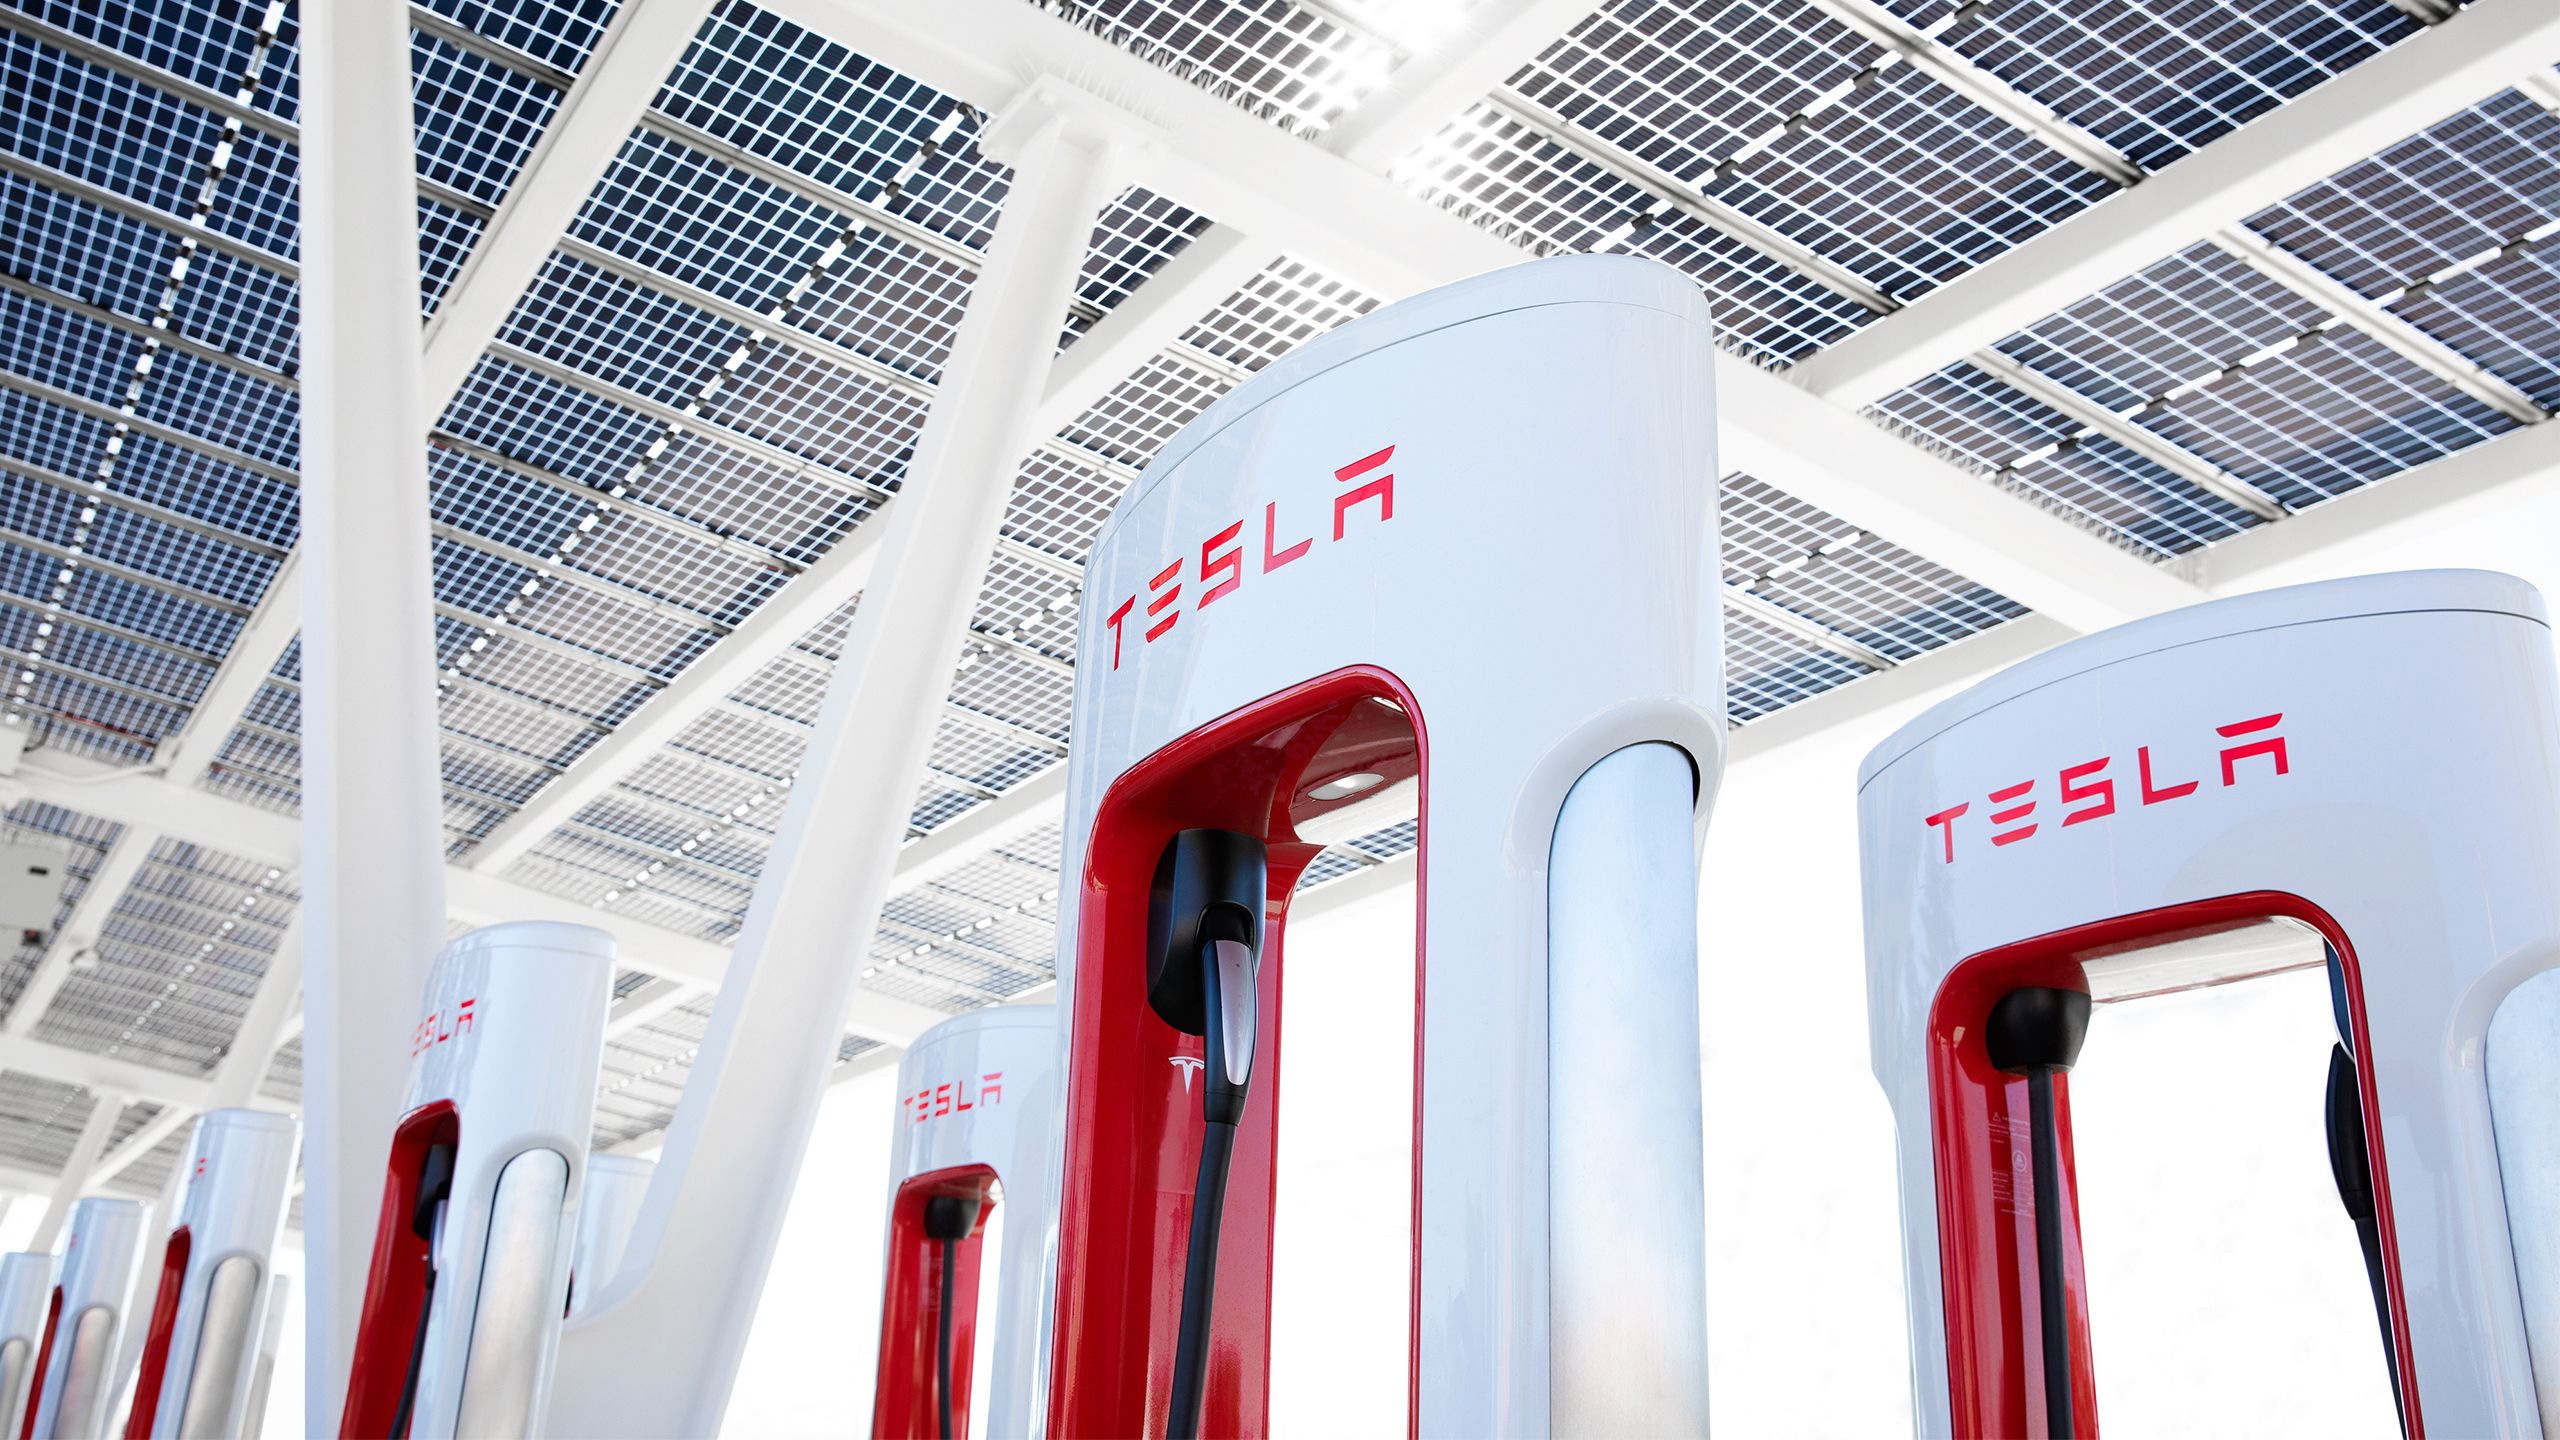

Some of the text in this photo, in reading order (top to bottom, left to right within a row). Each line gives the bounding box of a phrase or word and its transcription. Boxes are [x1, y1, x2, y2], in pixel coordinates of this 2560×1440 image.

[1106, 444, 1396, 671] TESLA
[1925, 712, 2289, 864] TESLA
[411, 998, 477, 1057] ESLA
[903, 1072, 1003, 1128] TESLA
